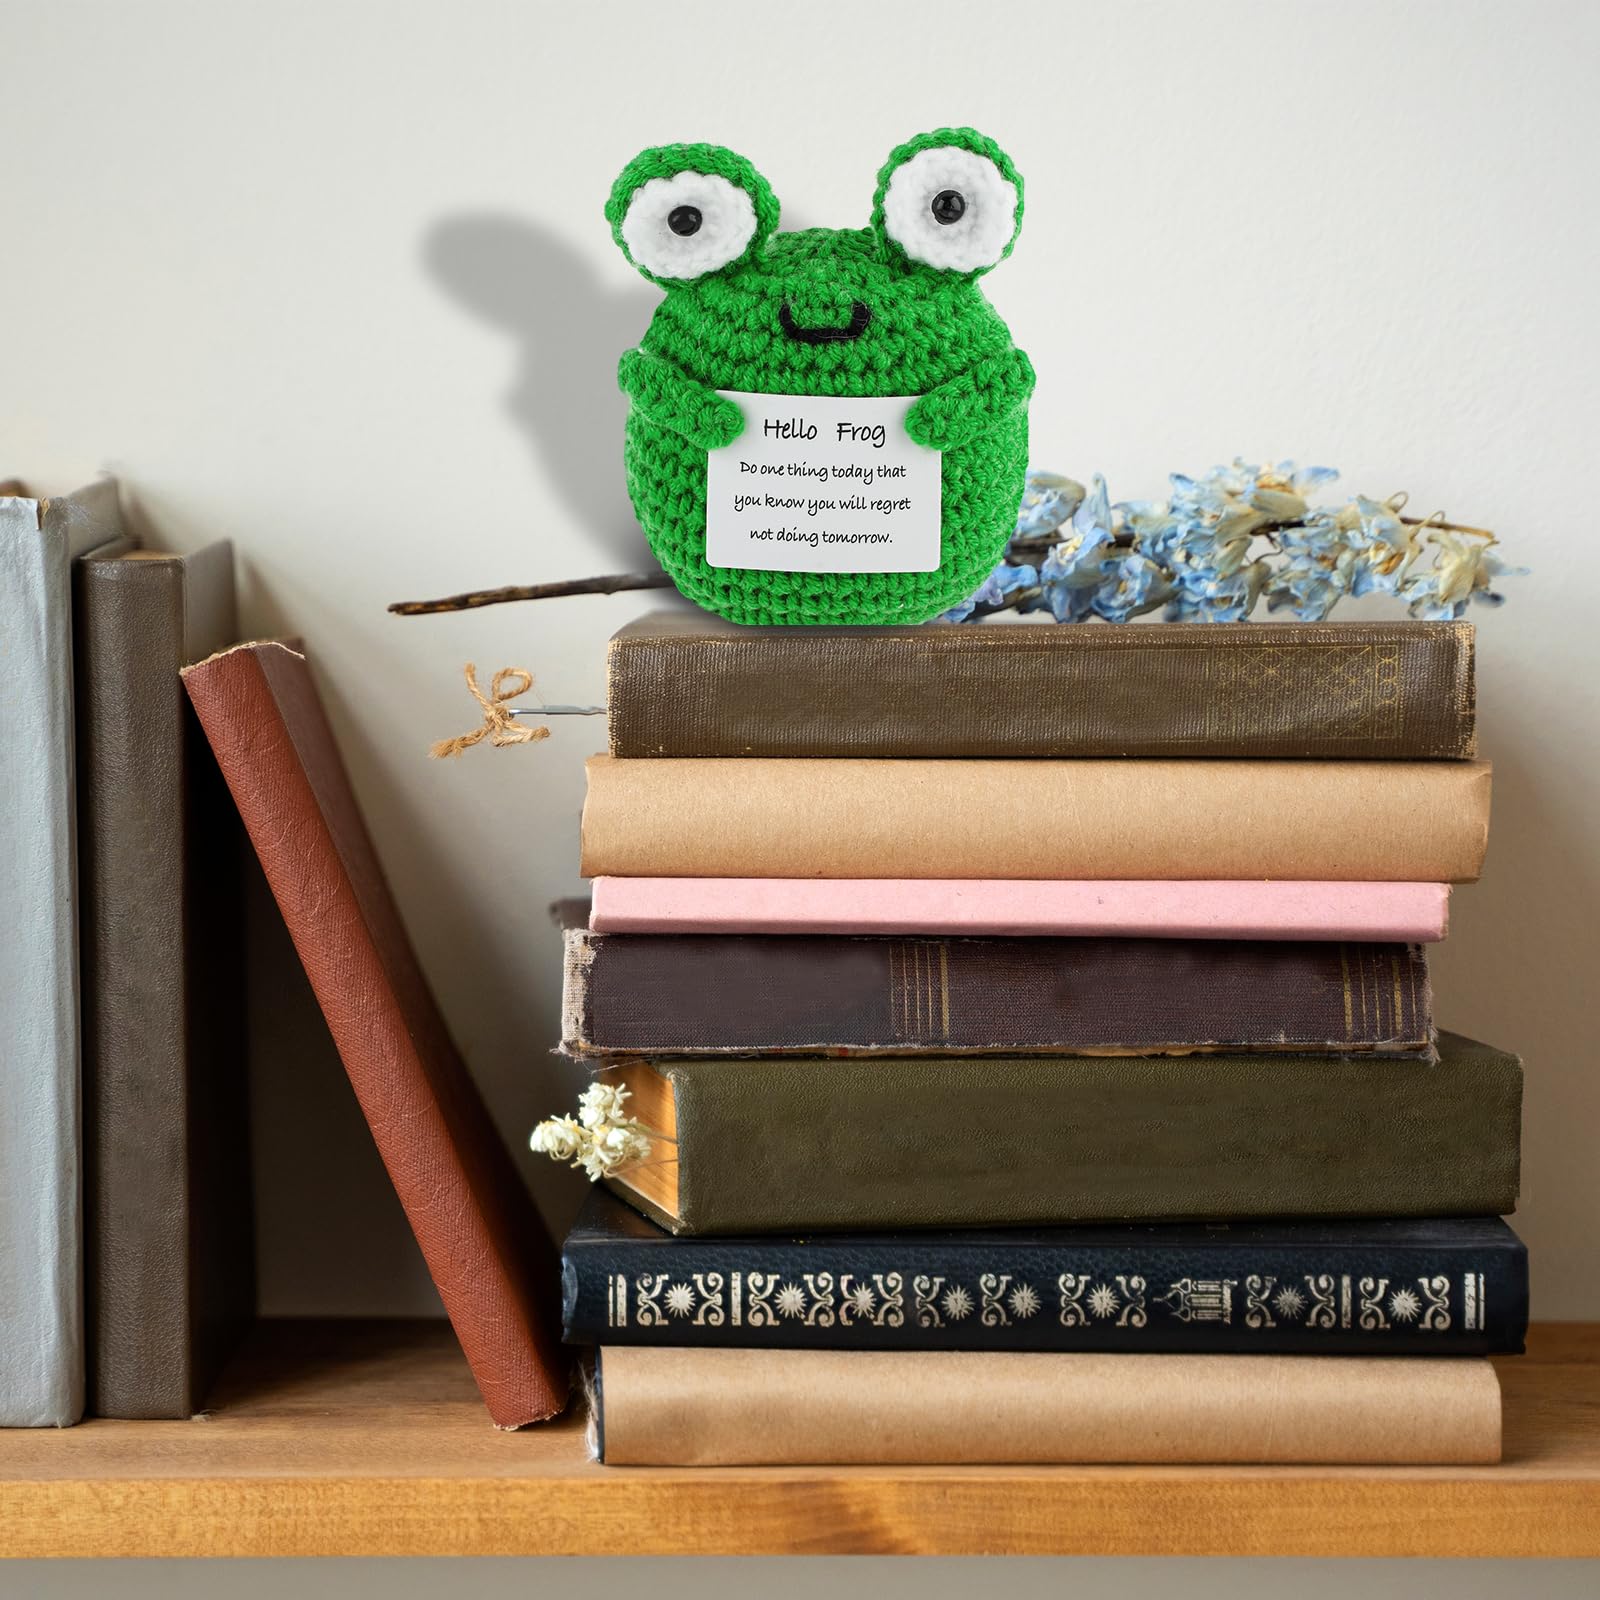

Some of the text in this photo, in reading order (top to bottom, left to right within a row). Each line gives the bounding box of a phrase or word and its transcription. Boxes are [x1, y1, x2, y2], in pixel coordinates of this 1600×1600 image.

[764, 418, 885, 448] Hello Frog
[740, 462, 906, 485] Do one thing today that
[734, 494, 911, 516] you know you will regret
[751, 527, 892, 547] not doing tomorrow.
